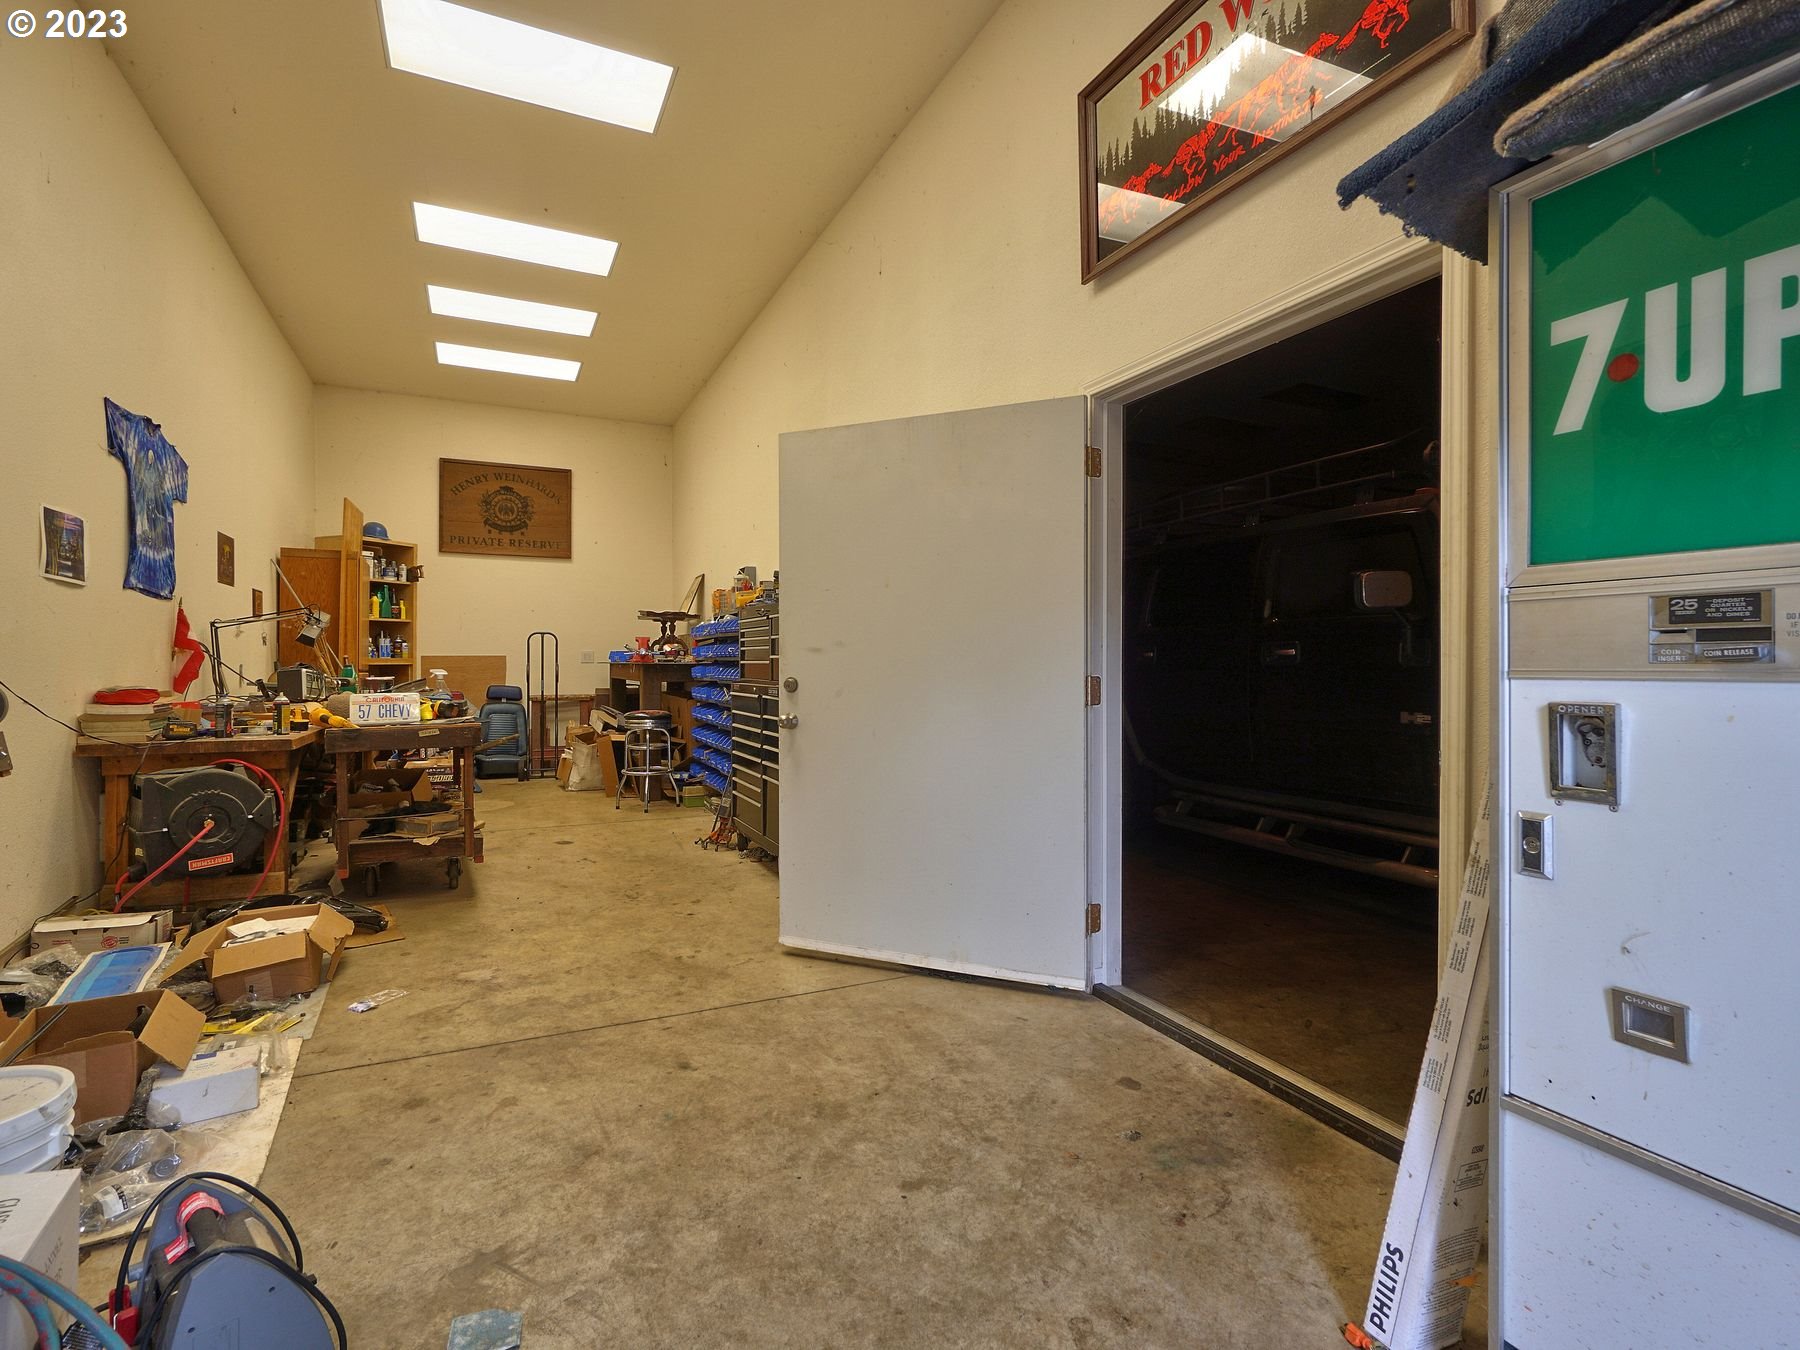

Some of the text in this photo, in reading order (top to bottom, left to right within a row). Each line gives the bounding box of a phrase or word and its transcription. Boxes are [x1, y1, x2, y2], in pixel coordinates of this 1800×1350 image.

[1138, 20, 1213, 111] RED
[1160, 168, 1207, 211] FOLLOW
[1213, 144, 1246, 175] YOUR
[450, 472, 489, 496] HENRY
[449, 535, 561, 550] PRIVATE RESERVE
[1670, 598, 1698, 611] 25
[1723, 648, 1755, 656] RELEASE
[358, 703, 412, 720] 57 CHEVY
[1558, 705, 1605, 715] OPENER
[1624, 995, 1671, 1013] CHANGE
[1467, 1087, 1489, 1108] IPS
[1369, 1242, 1404, 1334] PHILIPS
